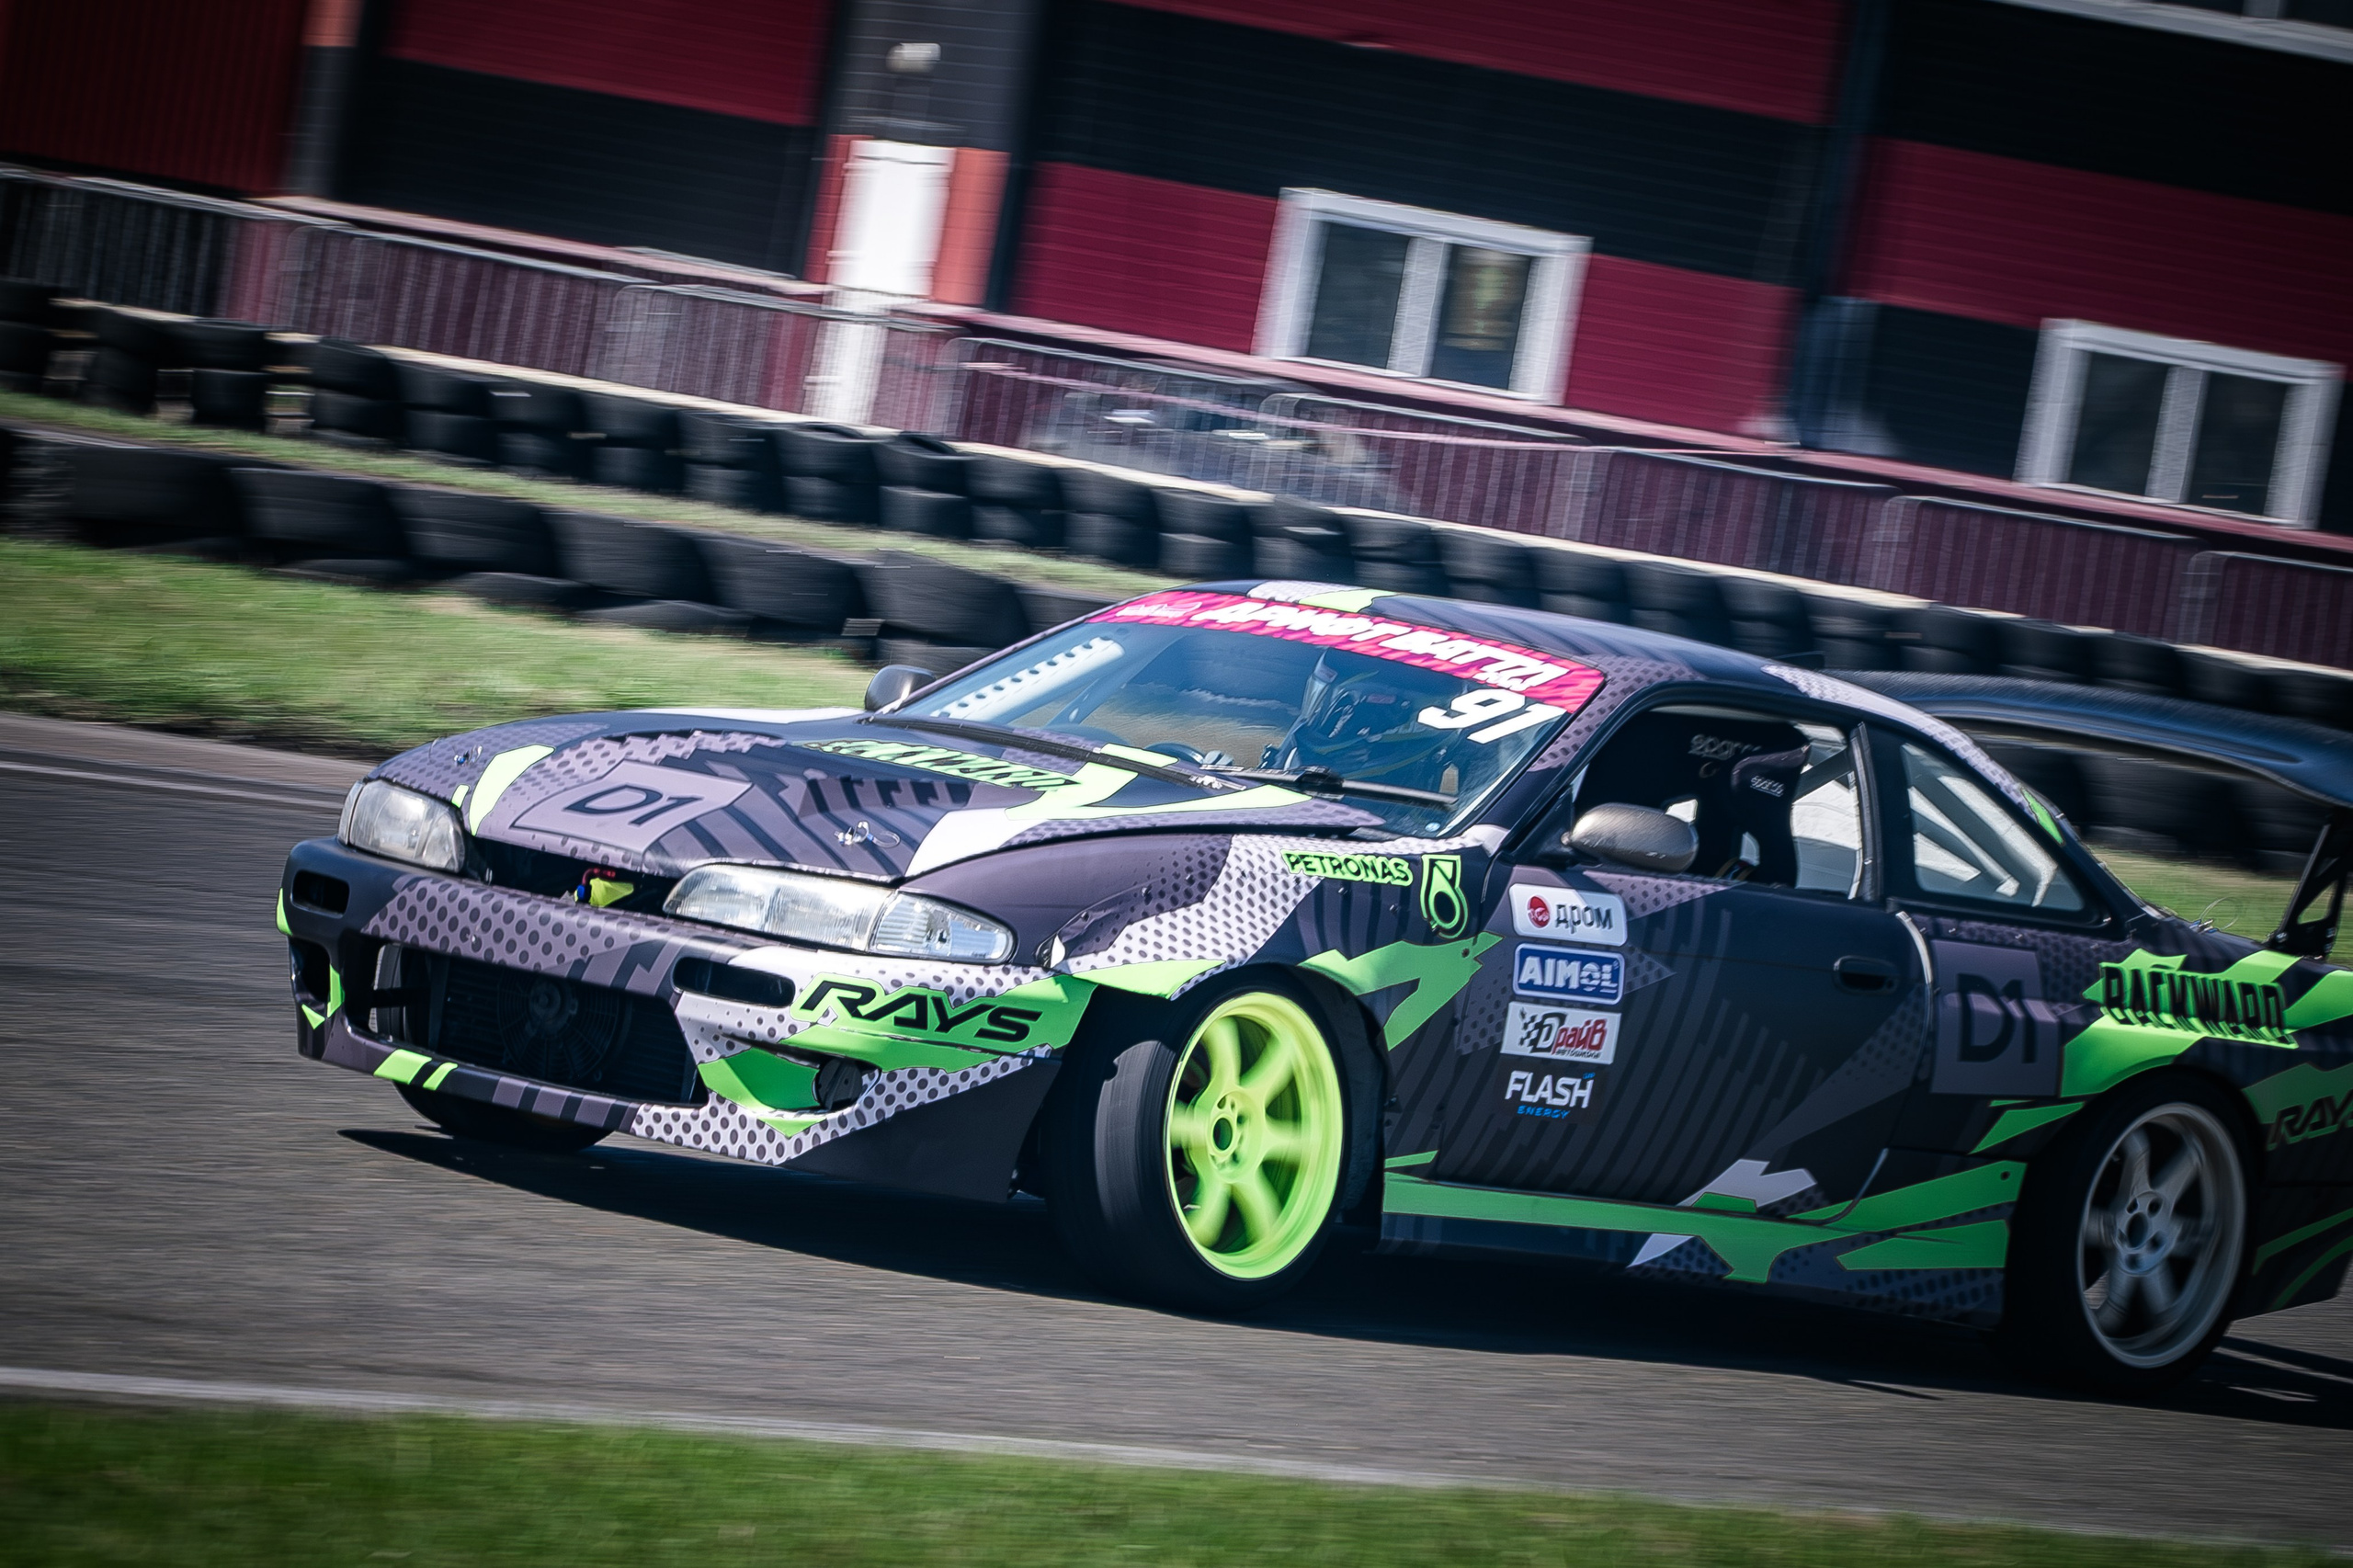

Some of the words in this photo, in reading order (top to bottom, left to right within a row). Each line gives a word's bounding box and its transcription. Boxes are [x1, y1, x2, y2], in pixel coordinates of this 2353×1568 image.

[563, 783, 705, 826] D1
[1284, 851, 1411, 884] PETRONAS
[1518, 955, 1619, 994] AIMOL
[799, 979, 1043, 1042] RAYS
[1956, 972, 2038, 1064] D1
[1505, 1070, 1595, 1108] FLASH
[1517, 1104, 1571, 1119] ENERGY
